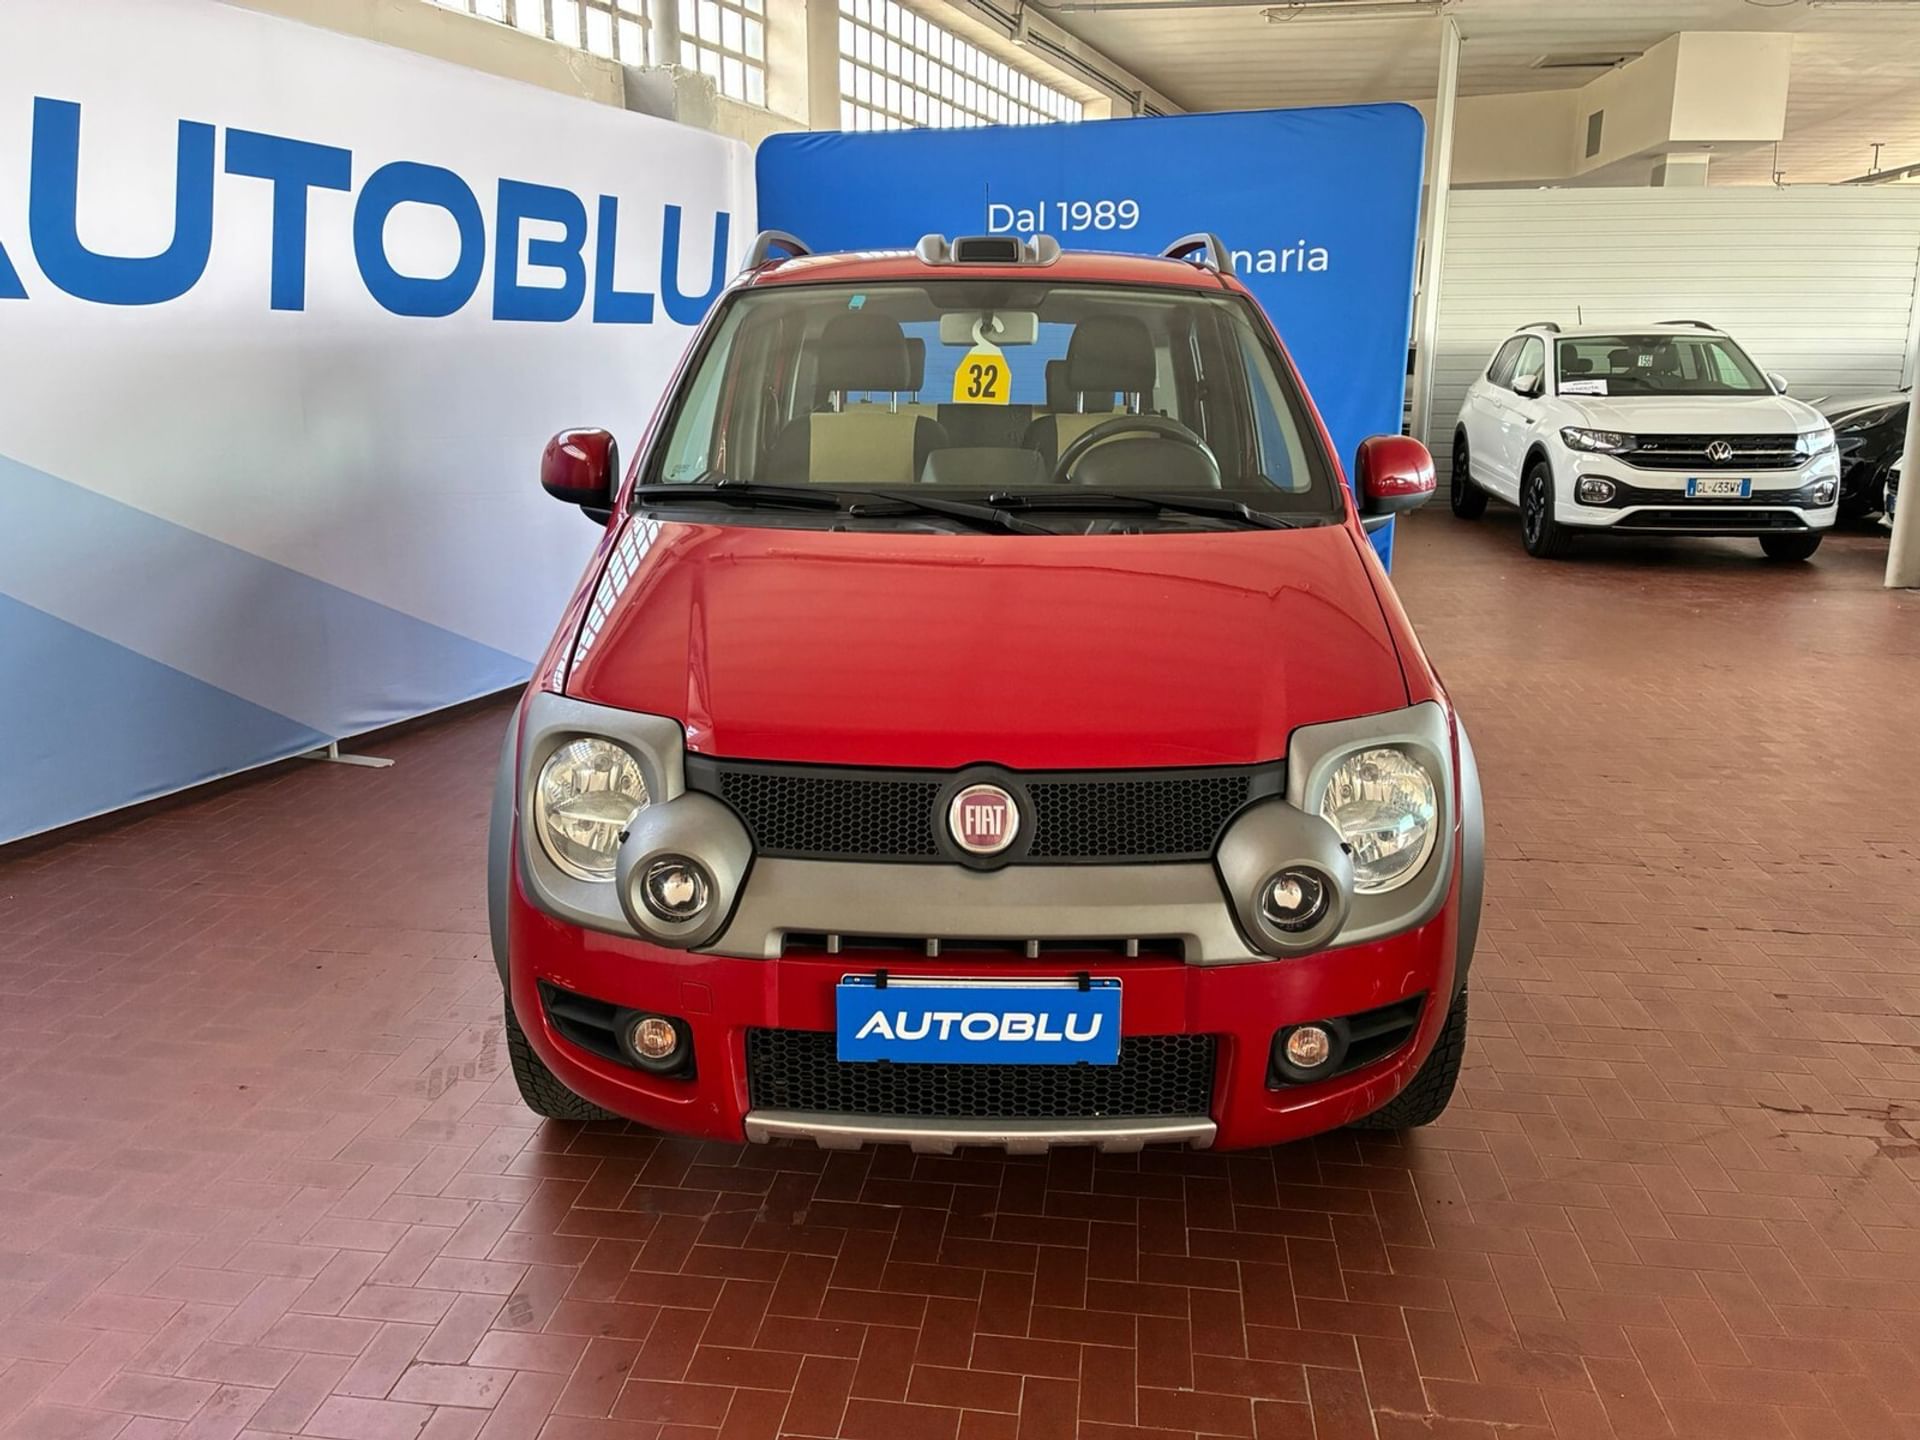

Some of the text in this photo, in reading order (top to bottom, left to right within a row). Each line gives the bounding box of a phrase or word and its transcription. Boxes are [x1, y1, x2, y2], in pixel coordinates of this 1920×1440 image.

[0, 96, 730, 326] UTOBLU
[988, 199, 1140, 233] Dal 1989
[967, 363, 998, 398] 32
[965, 804, 1005, 836] FIAT
[855, 1010, 1103, 1043] AUTOBLU
